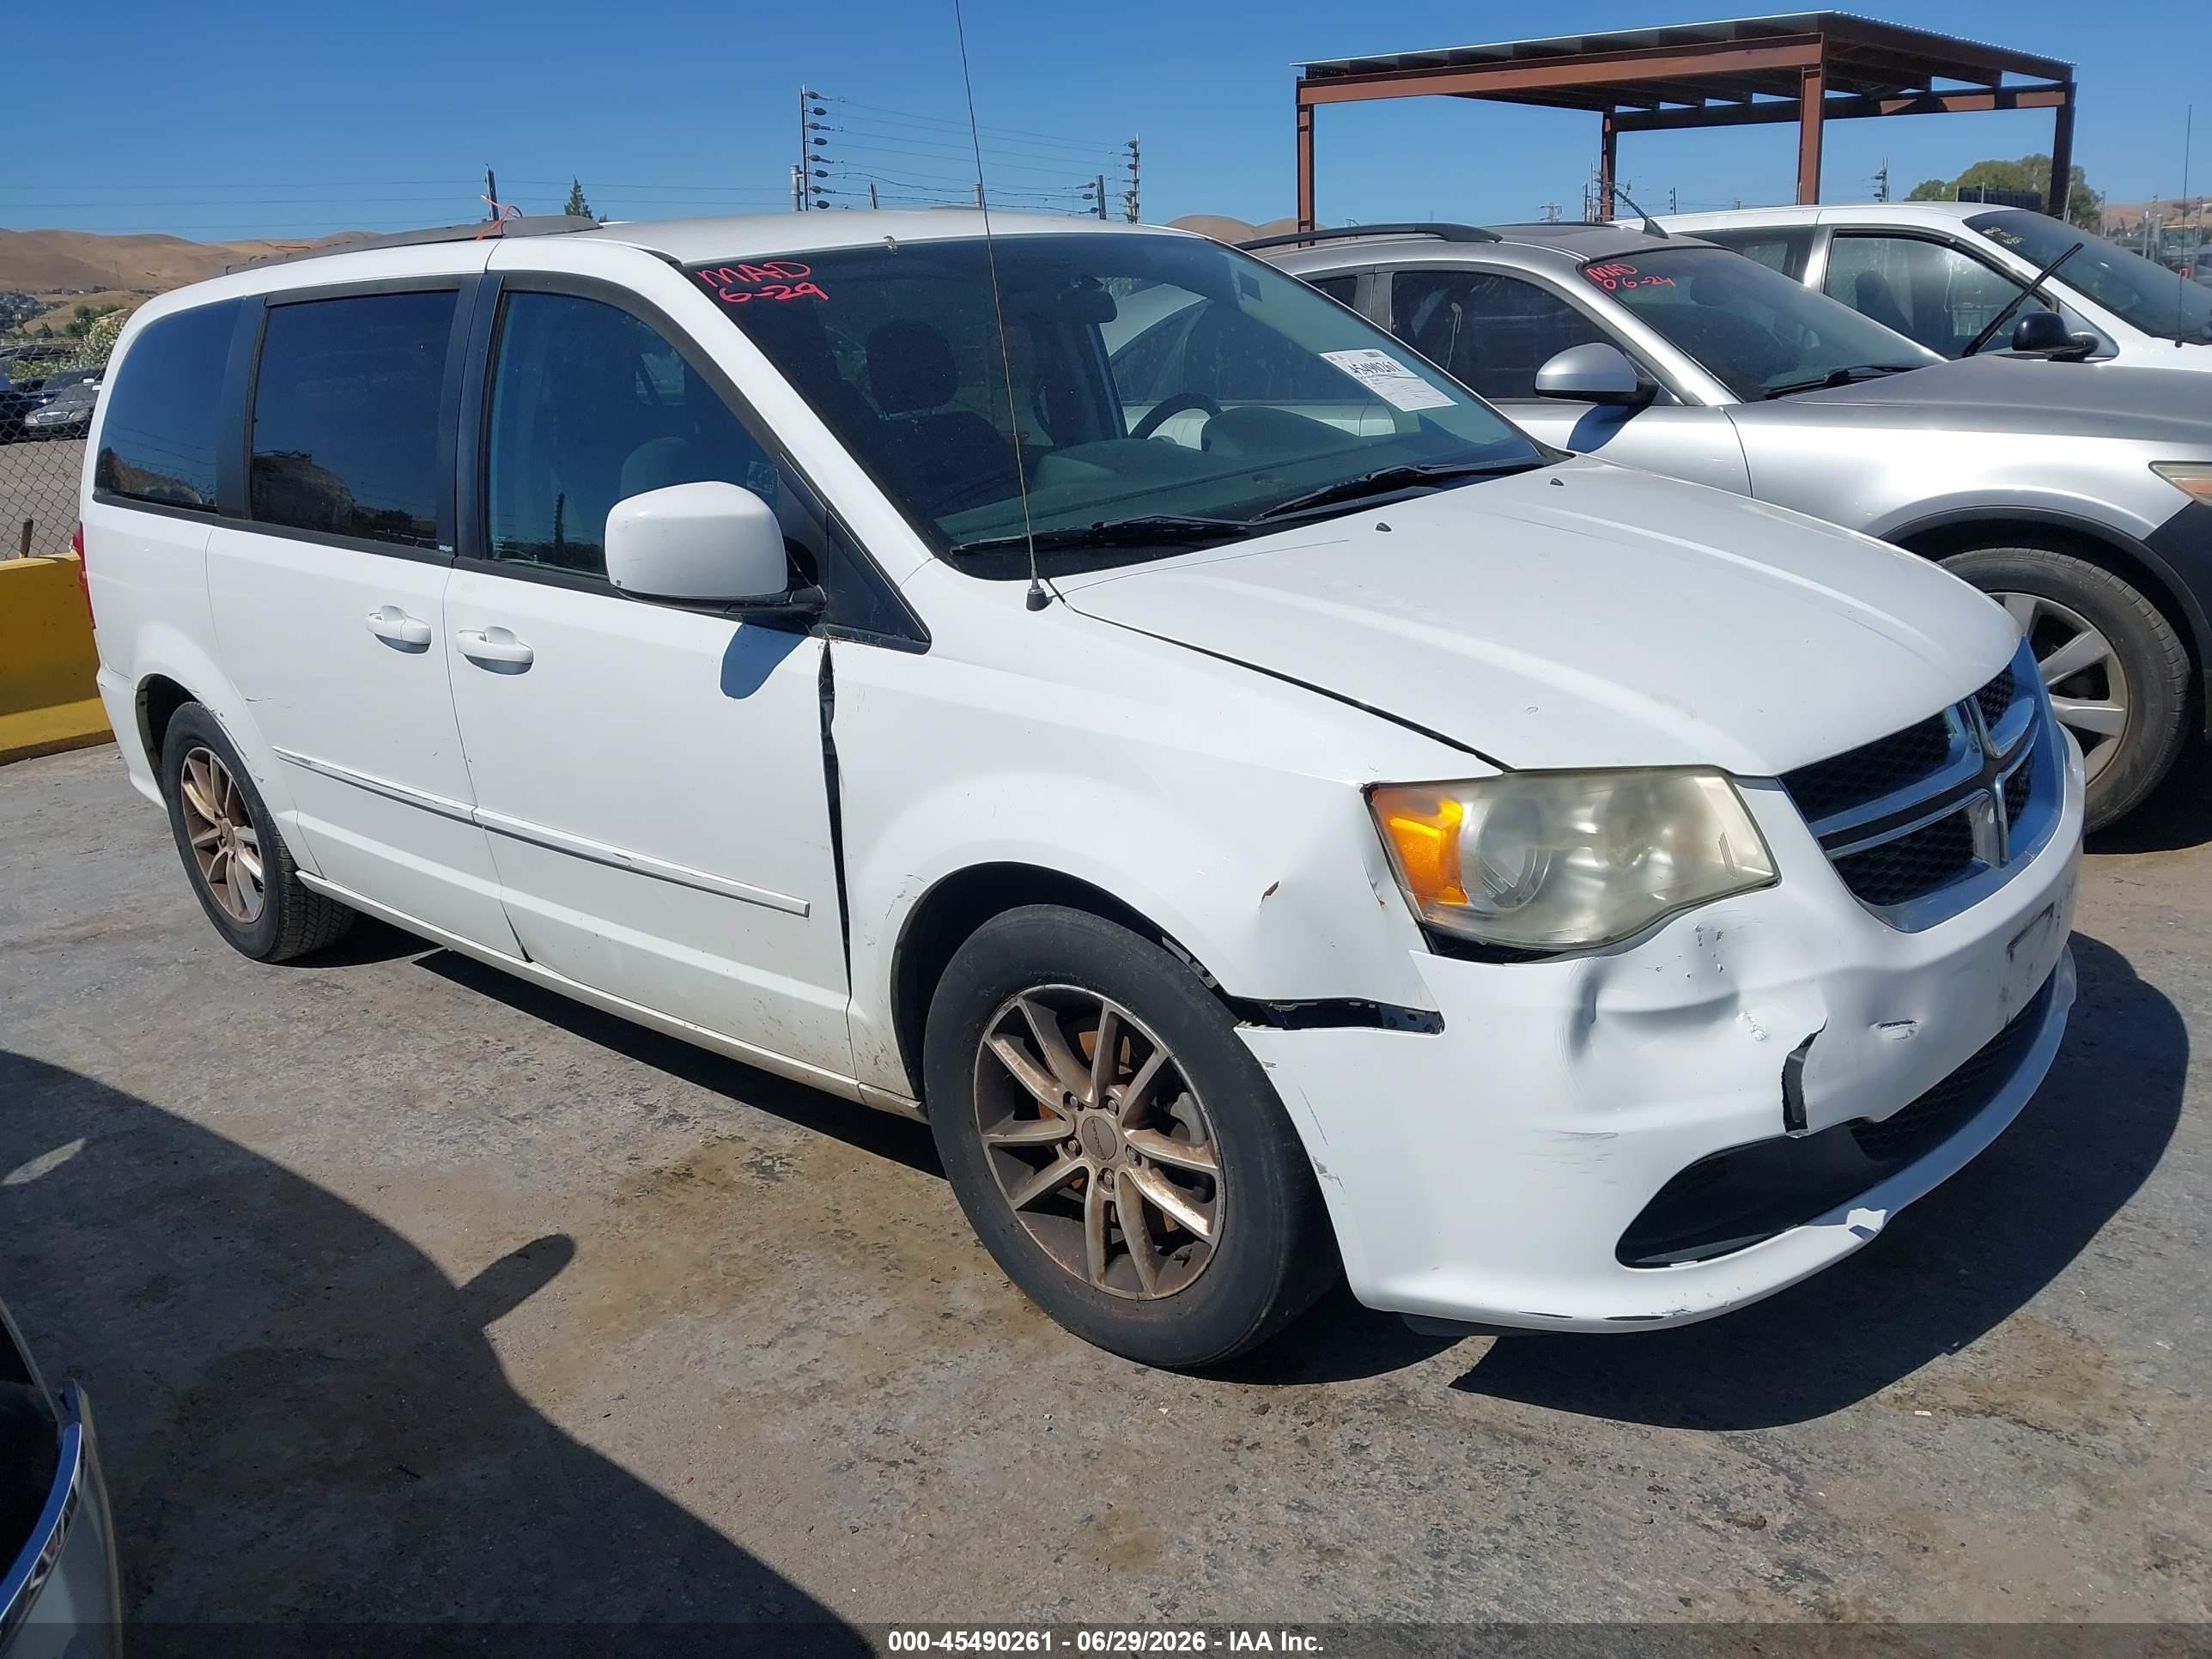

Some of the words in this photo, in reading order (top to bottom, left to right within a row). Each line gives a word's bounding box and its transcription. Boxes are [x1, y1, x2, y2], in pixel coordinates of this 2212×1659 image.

[696, 261, 811, 288] MAD
[1586, 263, 1638, 282] MAD
[719, 282, 830, 302] 6-29
[1347, 361, 1402, 375] 45490261
